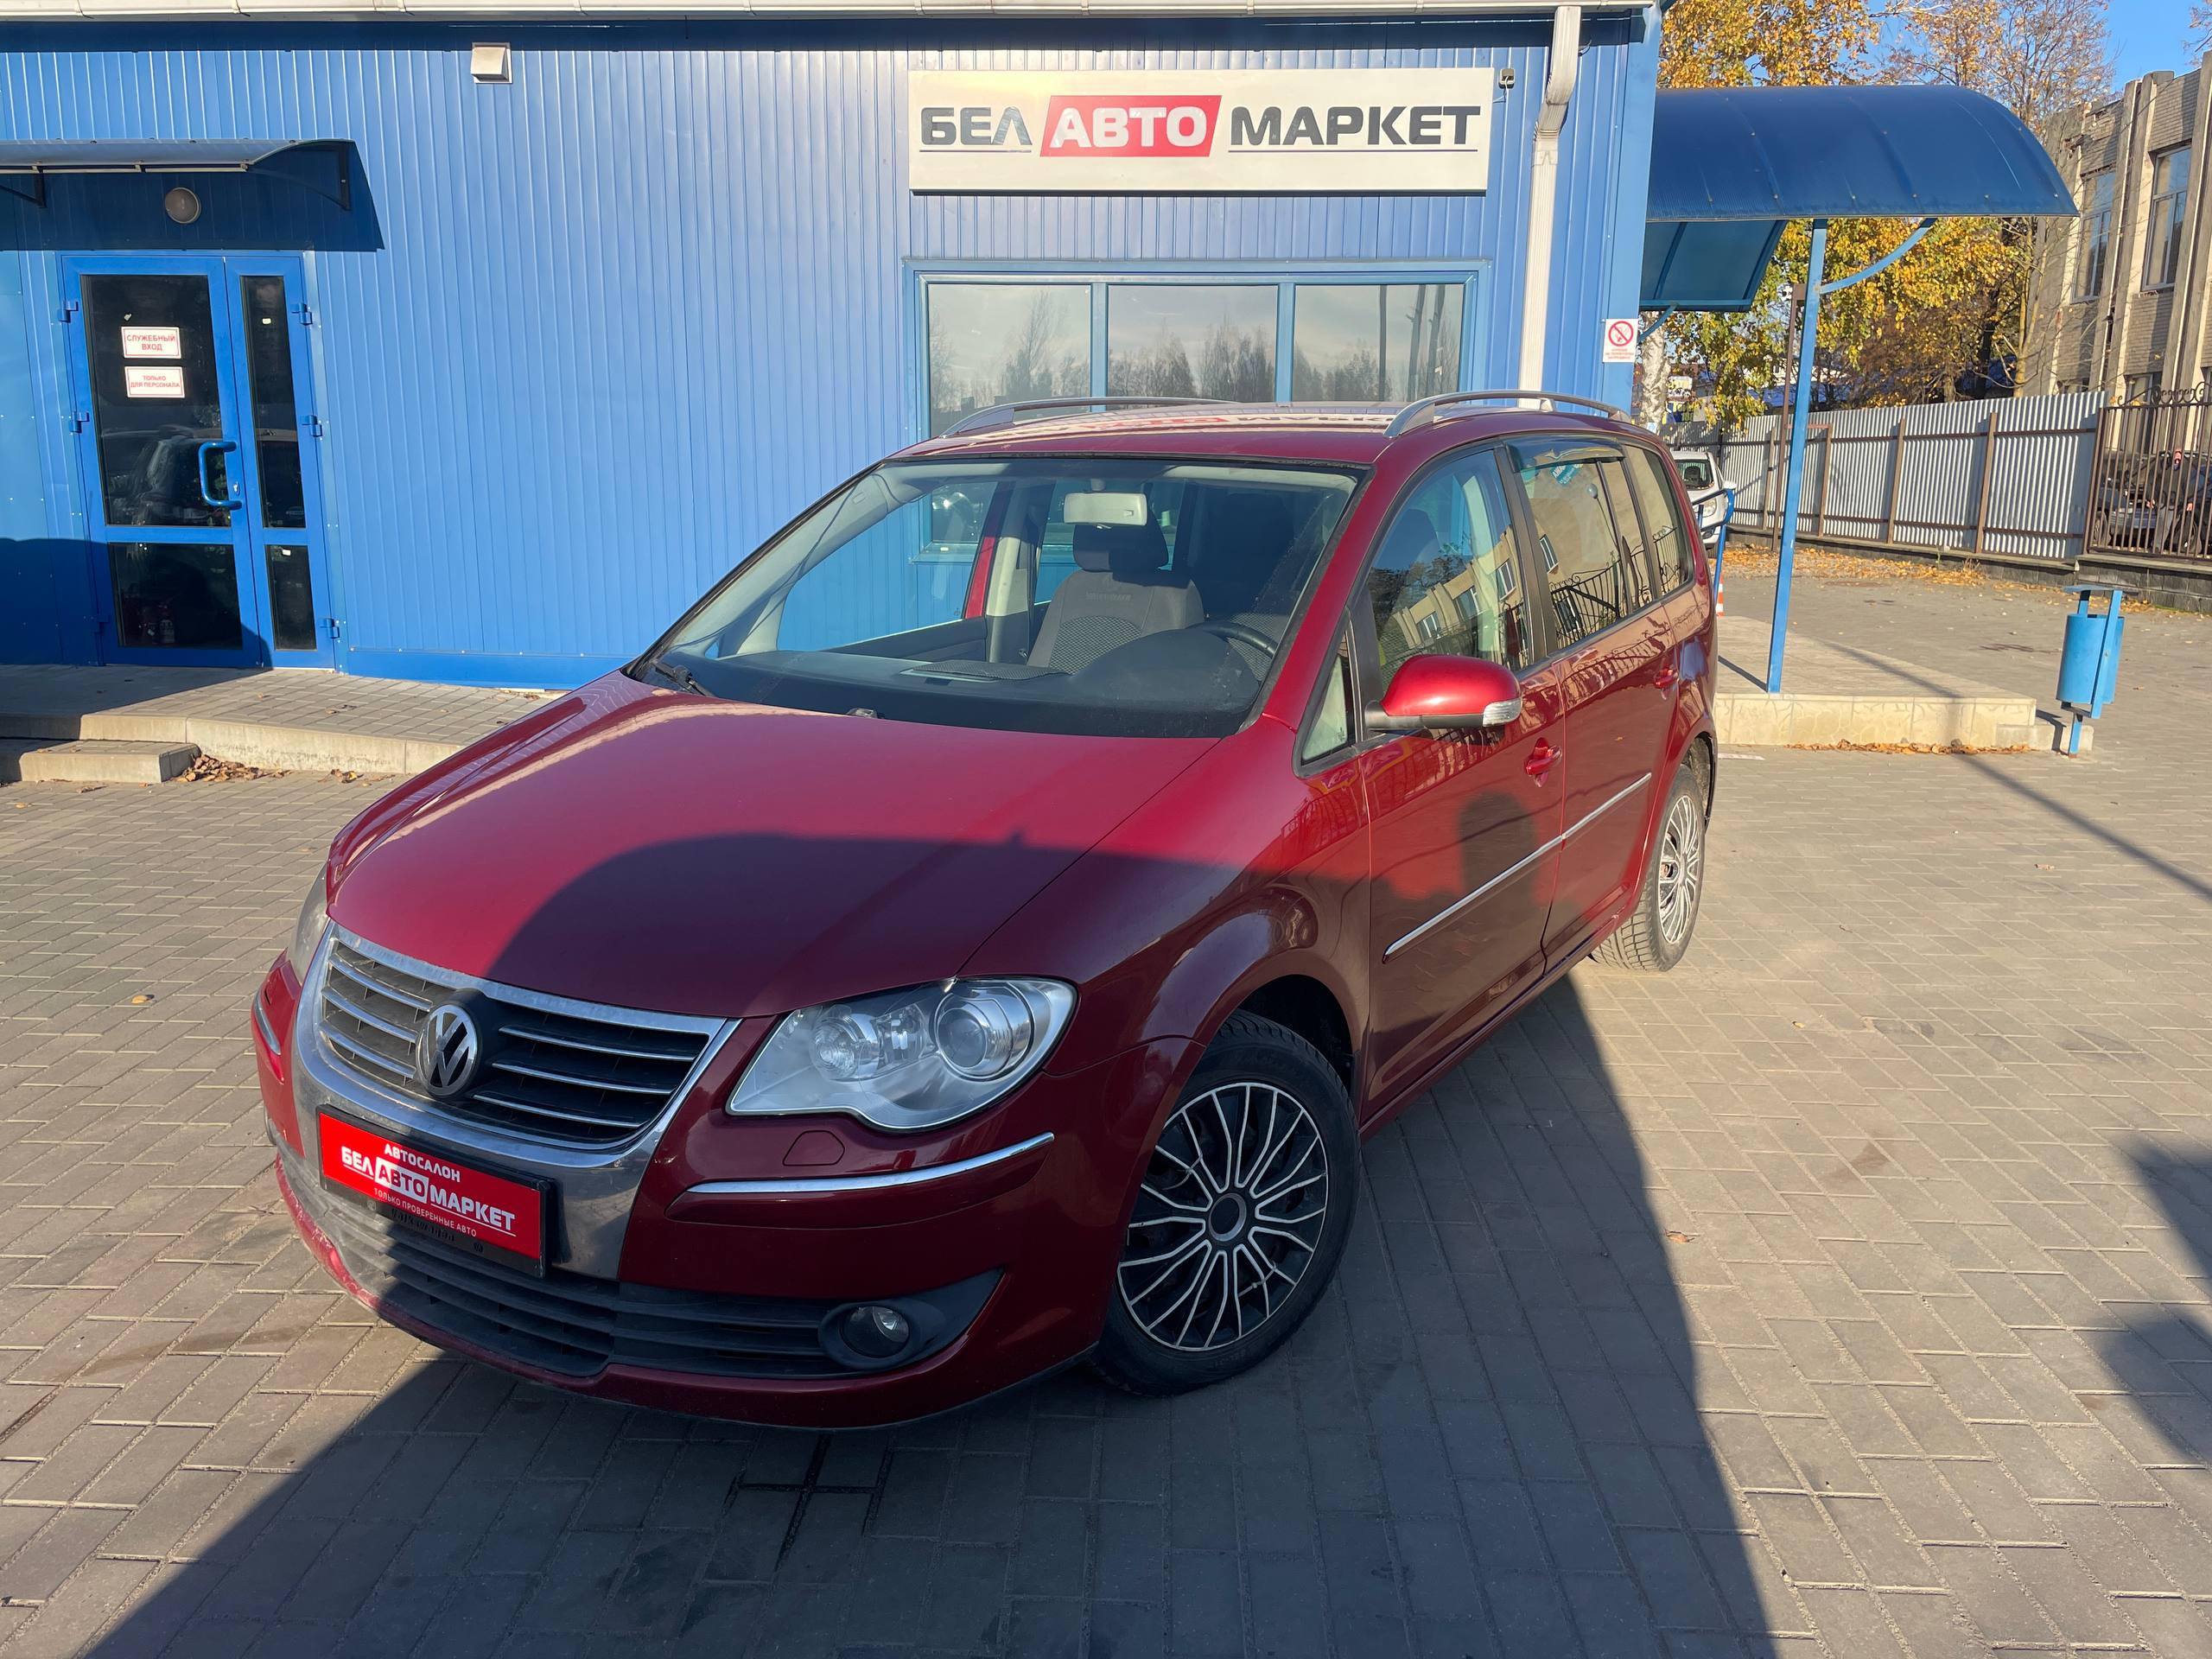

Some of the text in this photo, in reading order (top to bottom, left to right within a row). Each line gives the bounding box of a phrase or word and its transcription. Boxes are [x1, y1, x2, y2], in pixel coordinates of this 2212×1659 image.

[384, 1143, 461, 1182] АВТОСАЛОН
[373, 1187, 477, 1237] ТОЛЬКО ПРОВЕРЕННЫЕ АВТО
